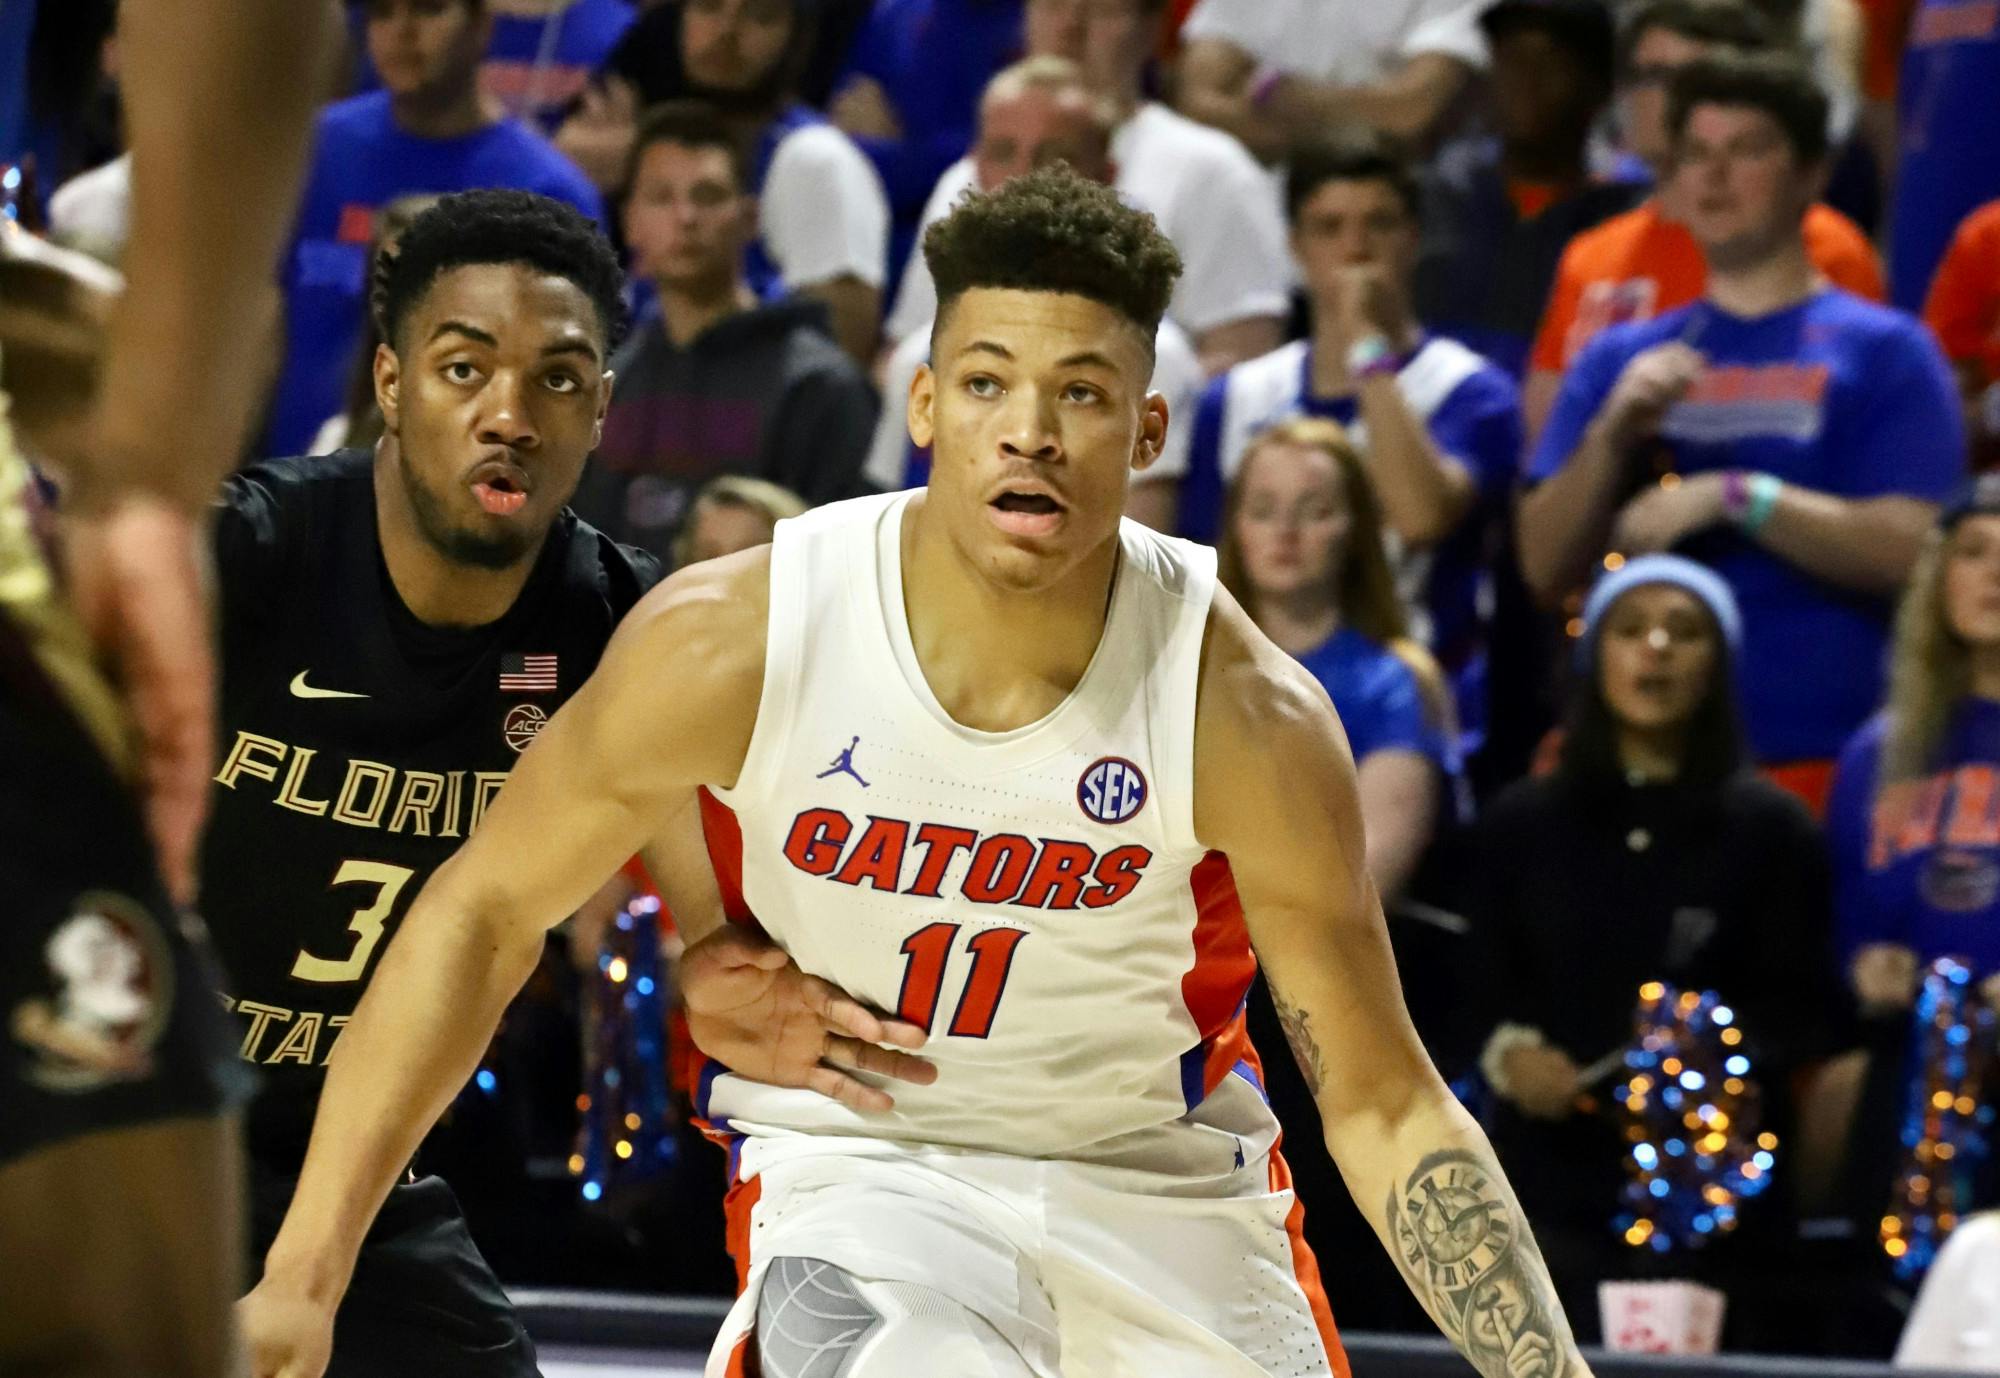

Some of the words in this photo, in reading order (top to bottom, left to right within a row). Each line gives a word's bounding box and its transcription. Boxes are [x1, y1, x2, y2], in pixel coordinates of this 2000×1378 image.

[1083, 761, 1142, 820] SEC
[782, 807, 1154, 910] GATORS
[290, 860, 415, 983] 3
[214, 991, 351, 1066] TA
[896, 921, 1031, 1040] 11
